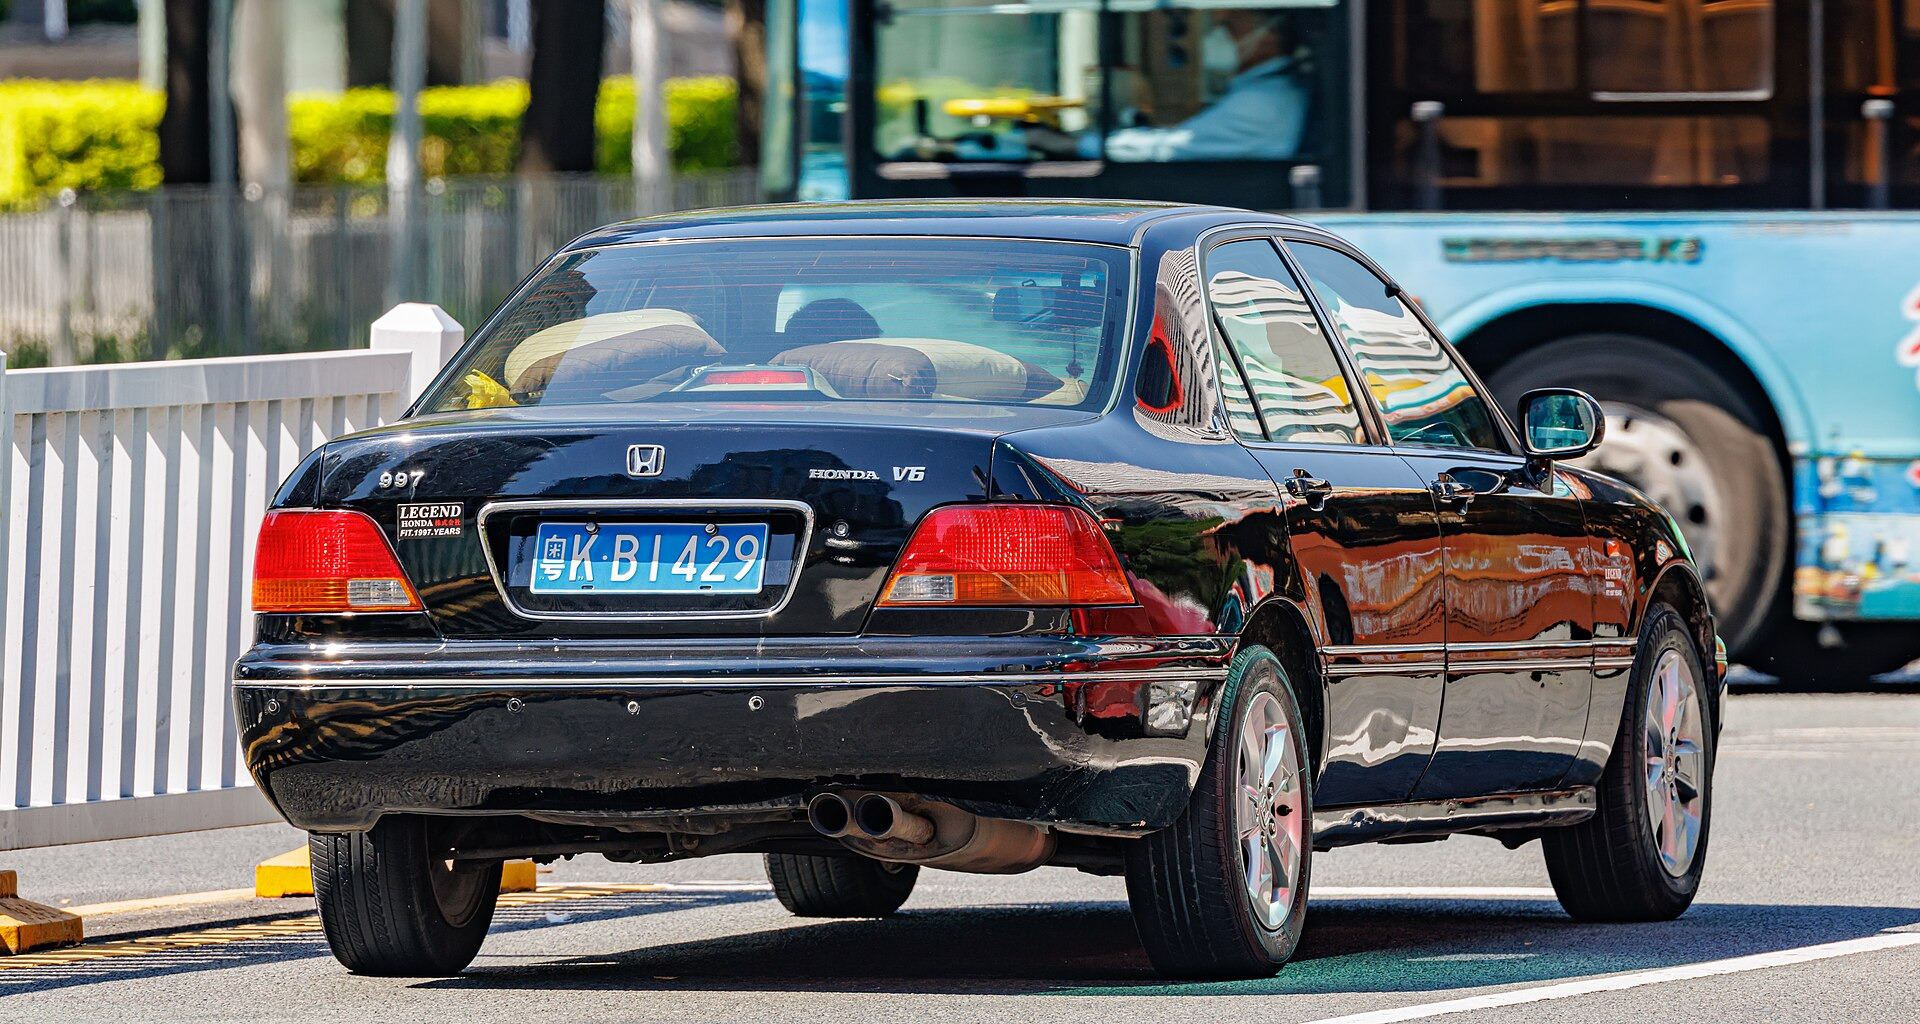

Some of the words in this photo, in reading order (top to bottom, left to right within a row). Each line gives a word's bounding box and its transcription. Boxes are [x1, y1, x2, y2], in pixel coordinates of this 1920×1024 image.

[379, 471, 425, 489] 997
[809, 469, 880, 480] HONDA
[892, 466, 926, 482] V6
[400, 505, 462, 519] LEGEND
[401, 519, 434, 528] HONDA
[434, 518, 461, 527] 株式会社
